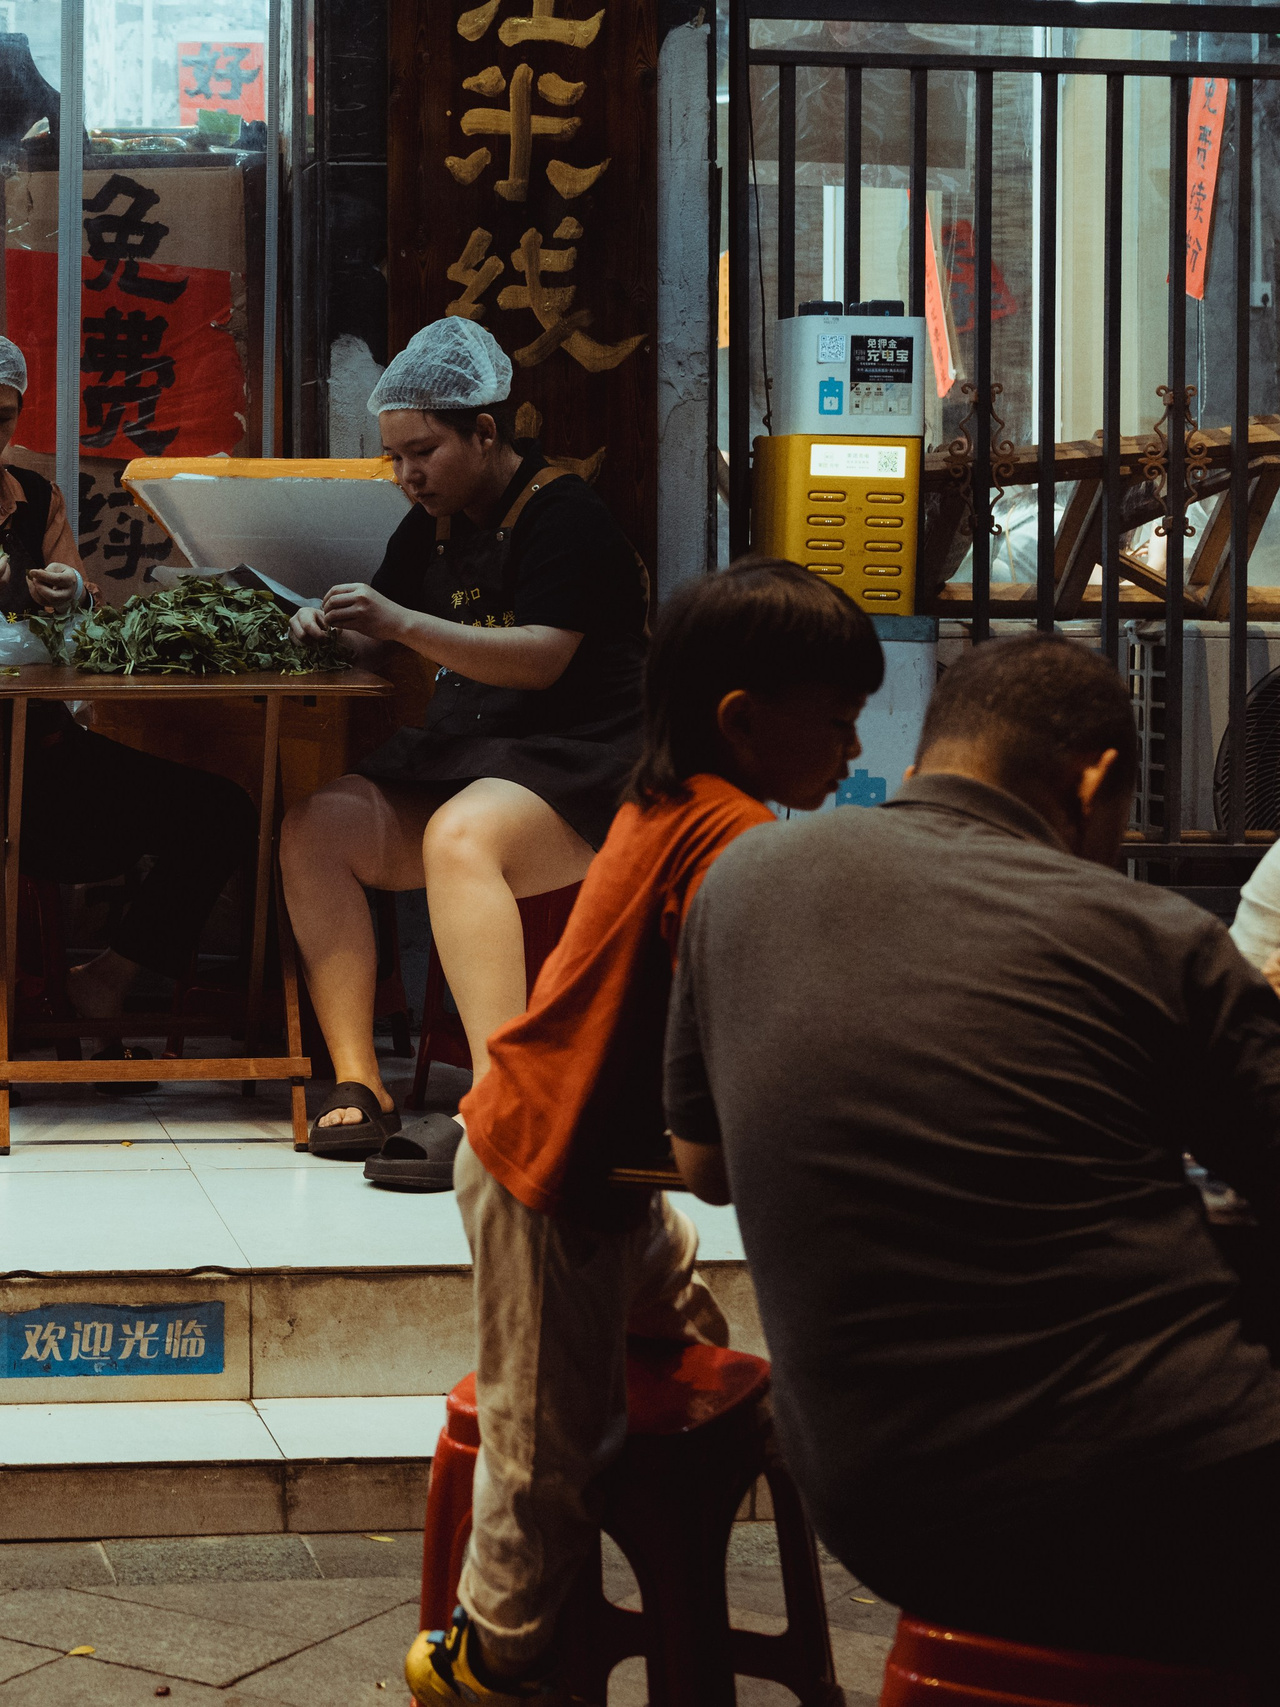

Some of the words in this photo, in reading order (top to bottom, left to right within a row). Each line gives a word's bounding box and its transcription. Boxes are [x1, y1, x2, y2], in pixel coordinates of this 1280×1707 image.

[181, 42, 262, 100] 好
[867, 338, 898, 349] 免押金
[866, 349, 909, 362] 充电宝
[450, 587, 481, 609] 窄口
[20, 1319, 208, 1361] 欢迎光临
